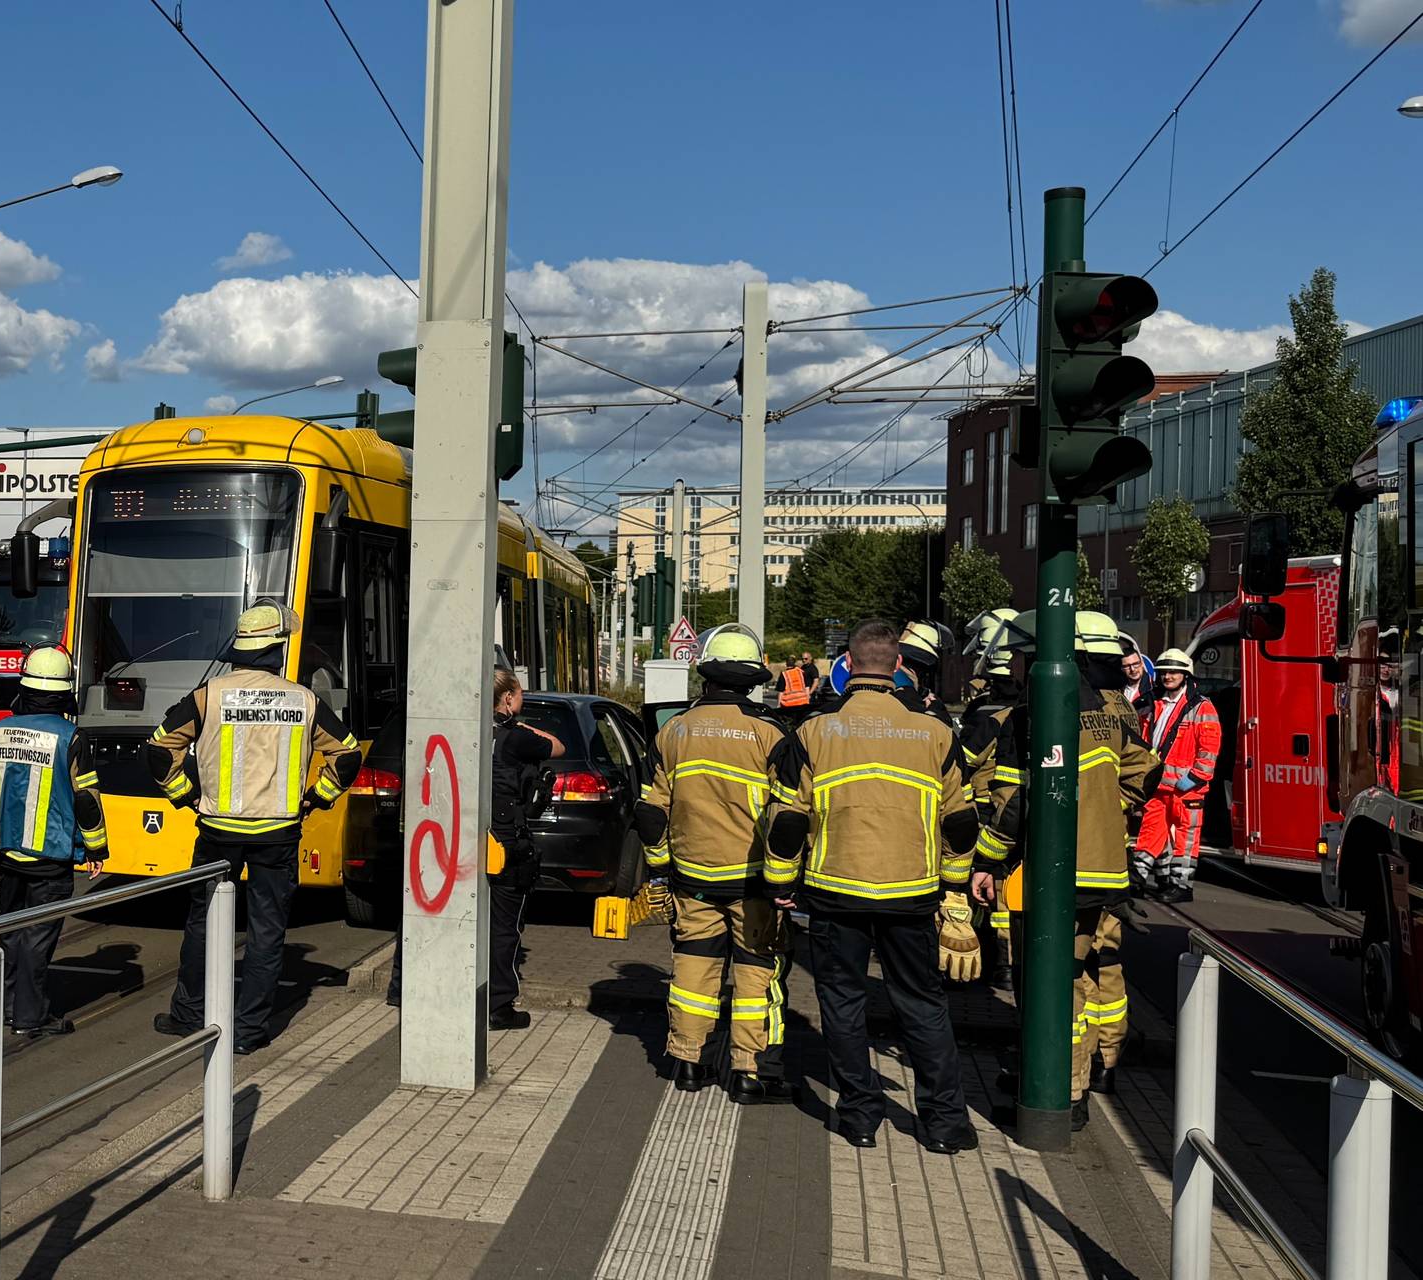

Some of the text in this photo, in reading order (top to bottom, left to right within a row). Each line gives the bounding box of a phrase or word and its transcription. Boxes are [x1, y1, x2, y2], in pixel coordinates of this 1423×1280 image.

[1048, 587, 1074, 606] 24
[677, 650, 690, 660] 30
[225, 708, 302, 722] B-DIENST NORD
[849, 716, 892, 728] ESSEN
[692, 727, 756, 741] EUERWEHR
[850, 727, 931, 741] FEUERWEHR
